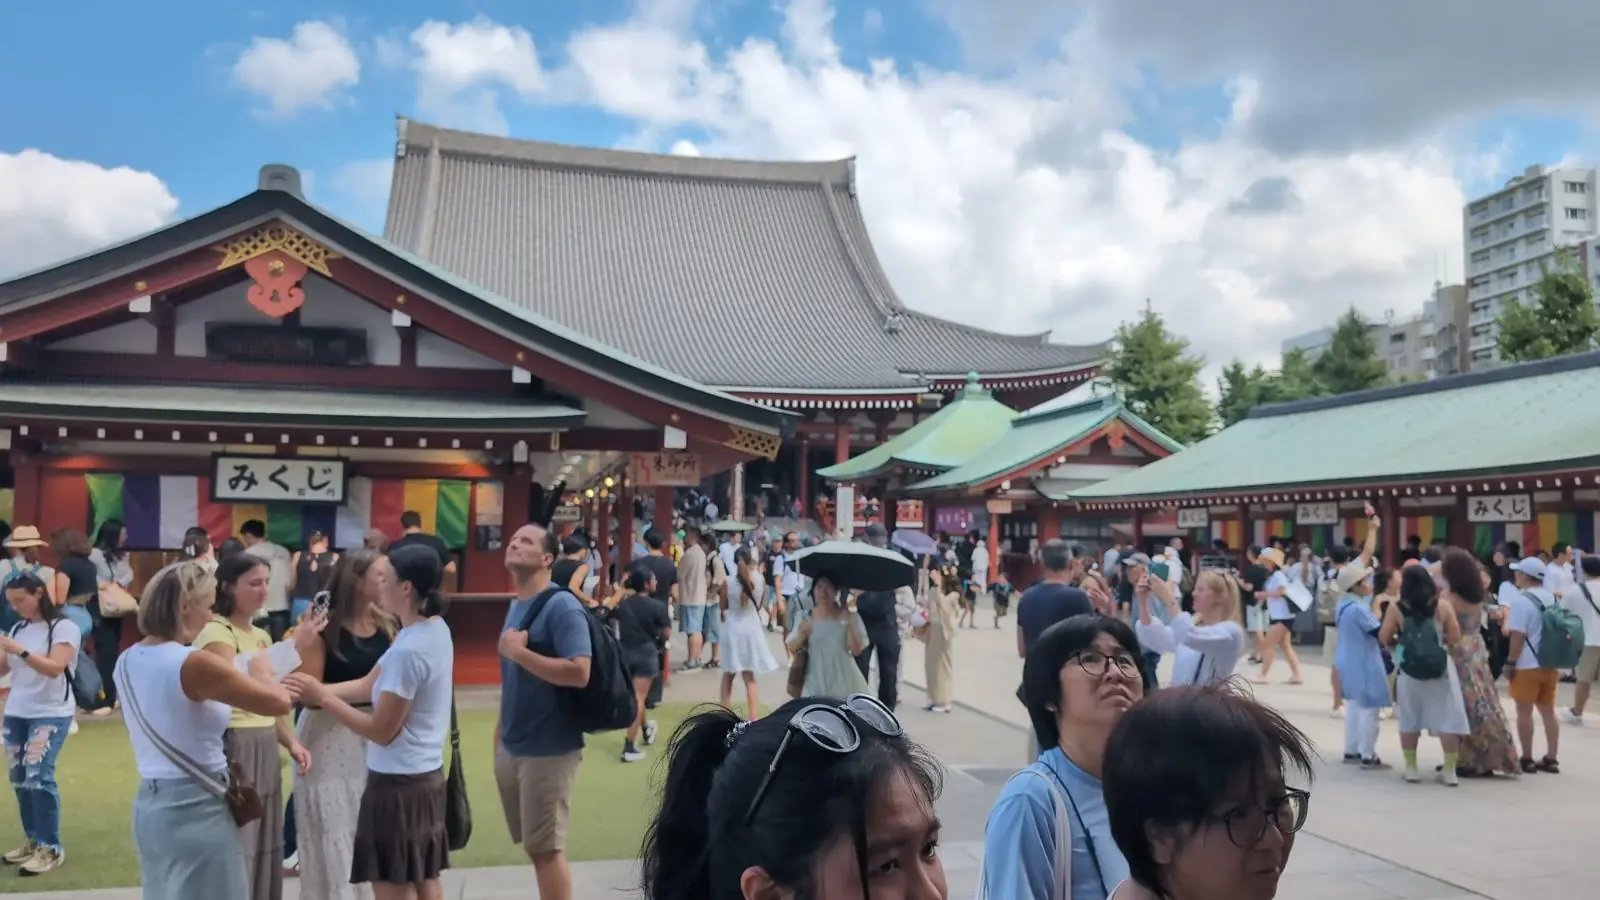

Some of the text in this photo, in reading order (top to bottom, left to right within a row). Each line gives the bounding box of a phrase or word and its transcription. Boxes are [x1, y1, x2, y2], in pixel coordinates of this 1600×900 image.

[228, 464, 332, 492] みくじ
[1474, 498, 1526, 516] みくじ
